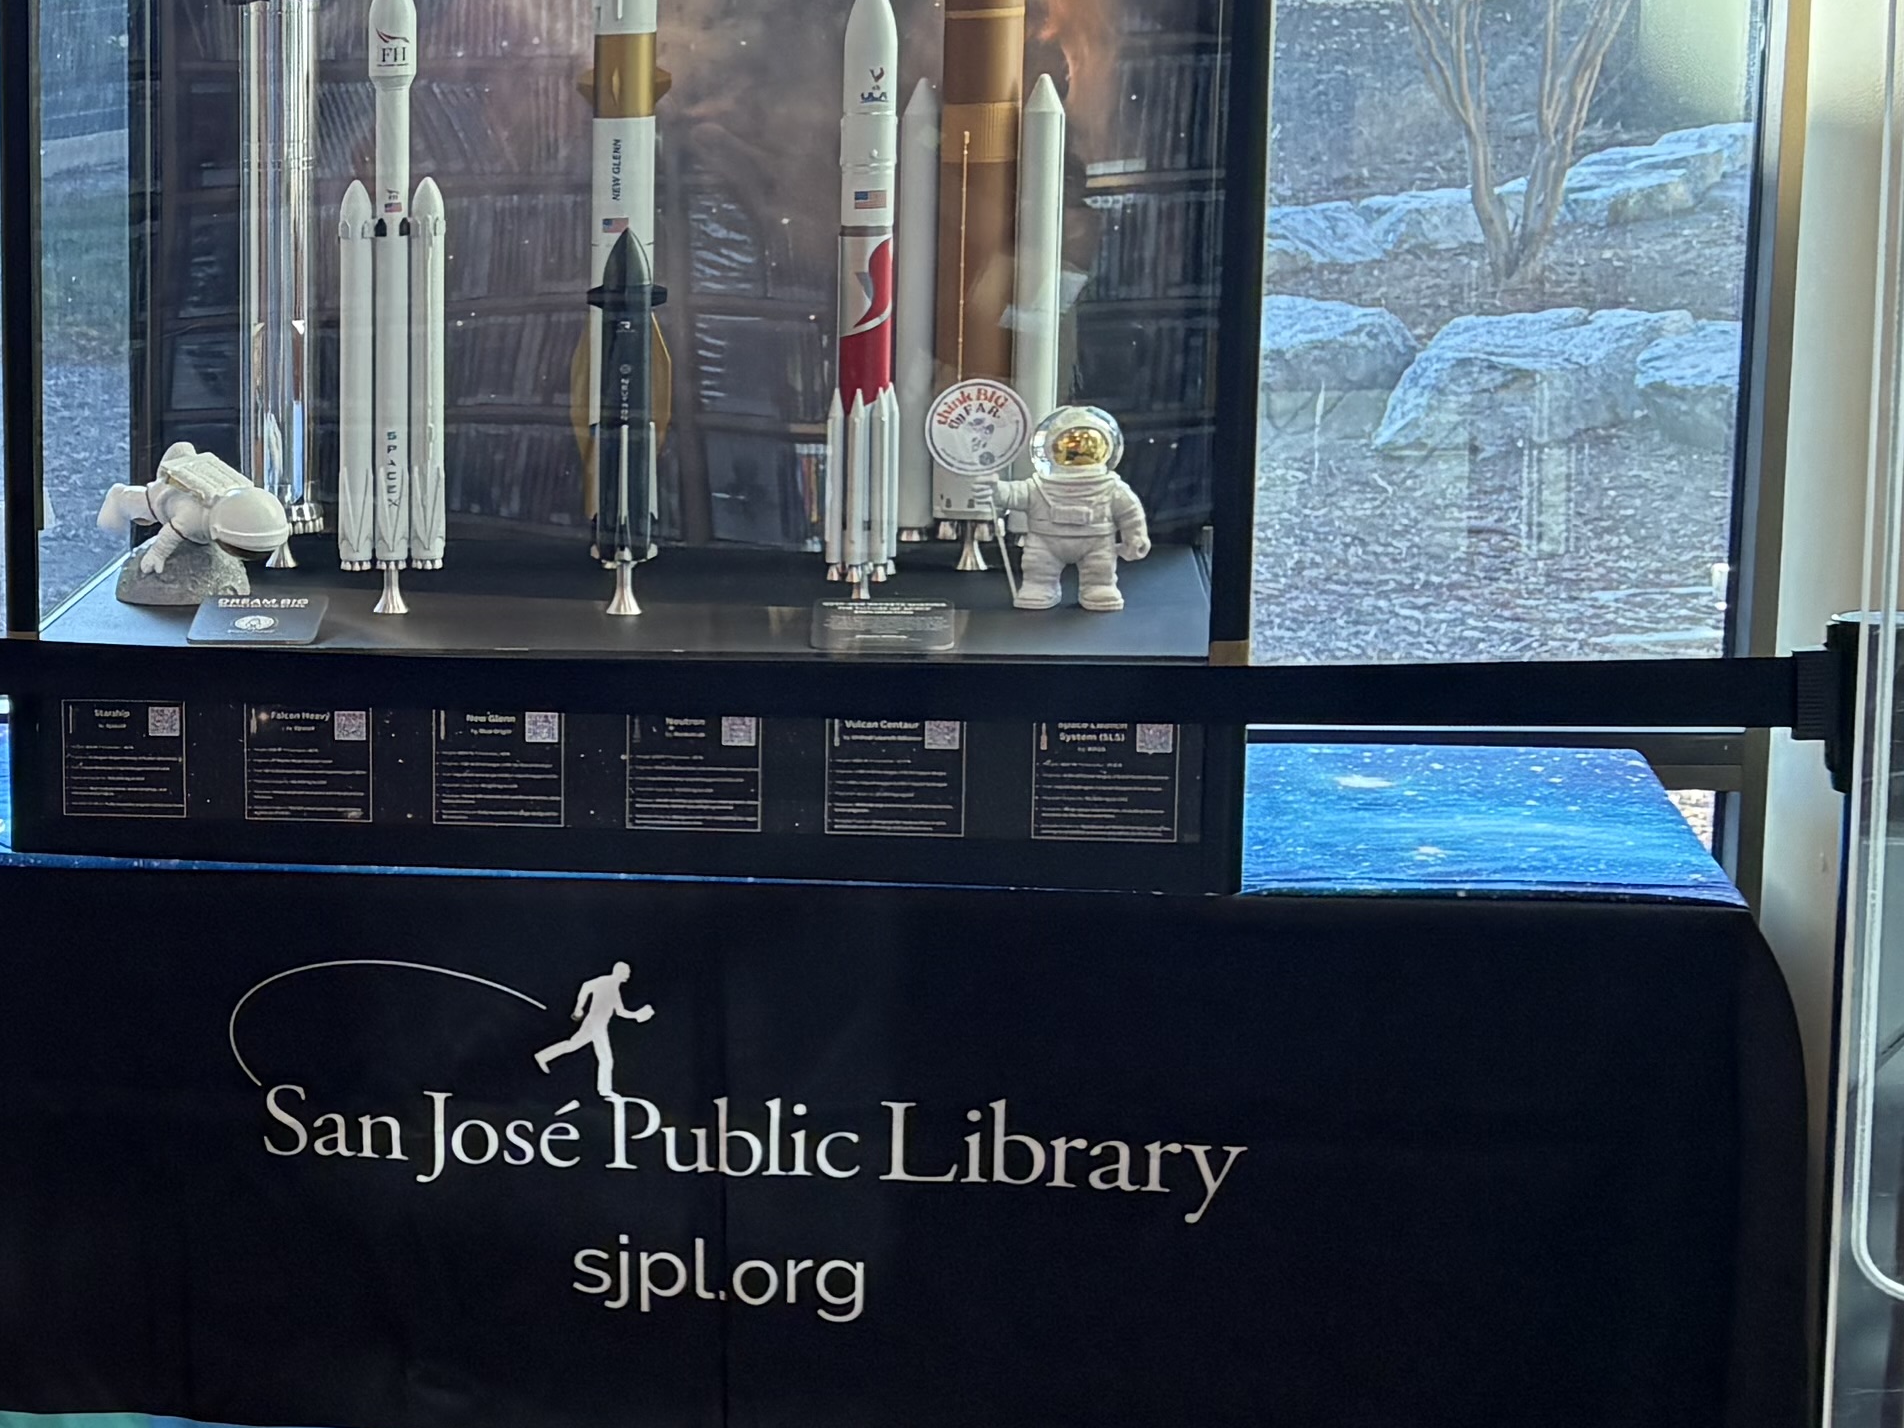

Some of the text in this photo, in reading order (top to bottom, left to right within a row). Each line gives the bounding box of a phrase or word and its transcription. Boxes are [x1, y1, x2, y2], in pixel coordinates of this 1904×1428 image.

[381, 47, 406, 63] FH
[976, 388, 1009, 409] BIG
[94, 708, 131, 719] Starship
[1059, 732, 1097, 743] System
[261, 1083, 1248, 1224] San José Public Library
[572, 1233, 867, 1322] sjpl.org
